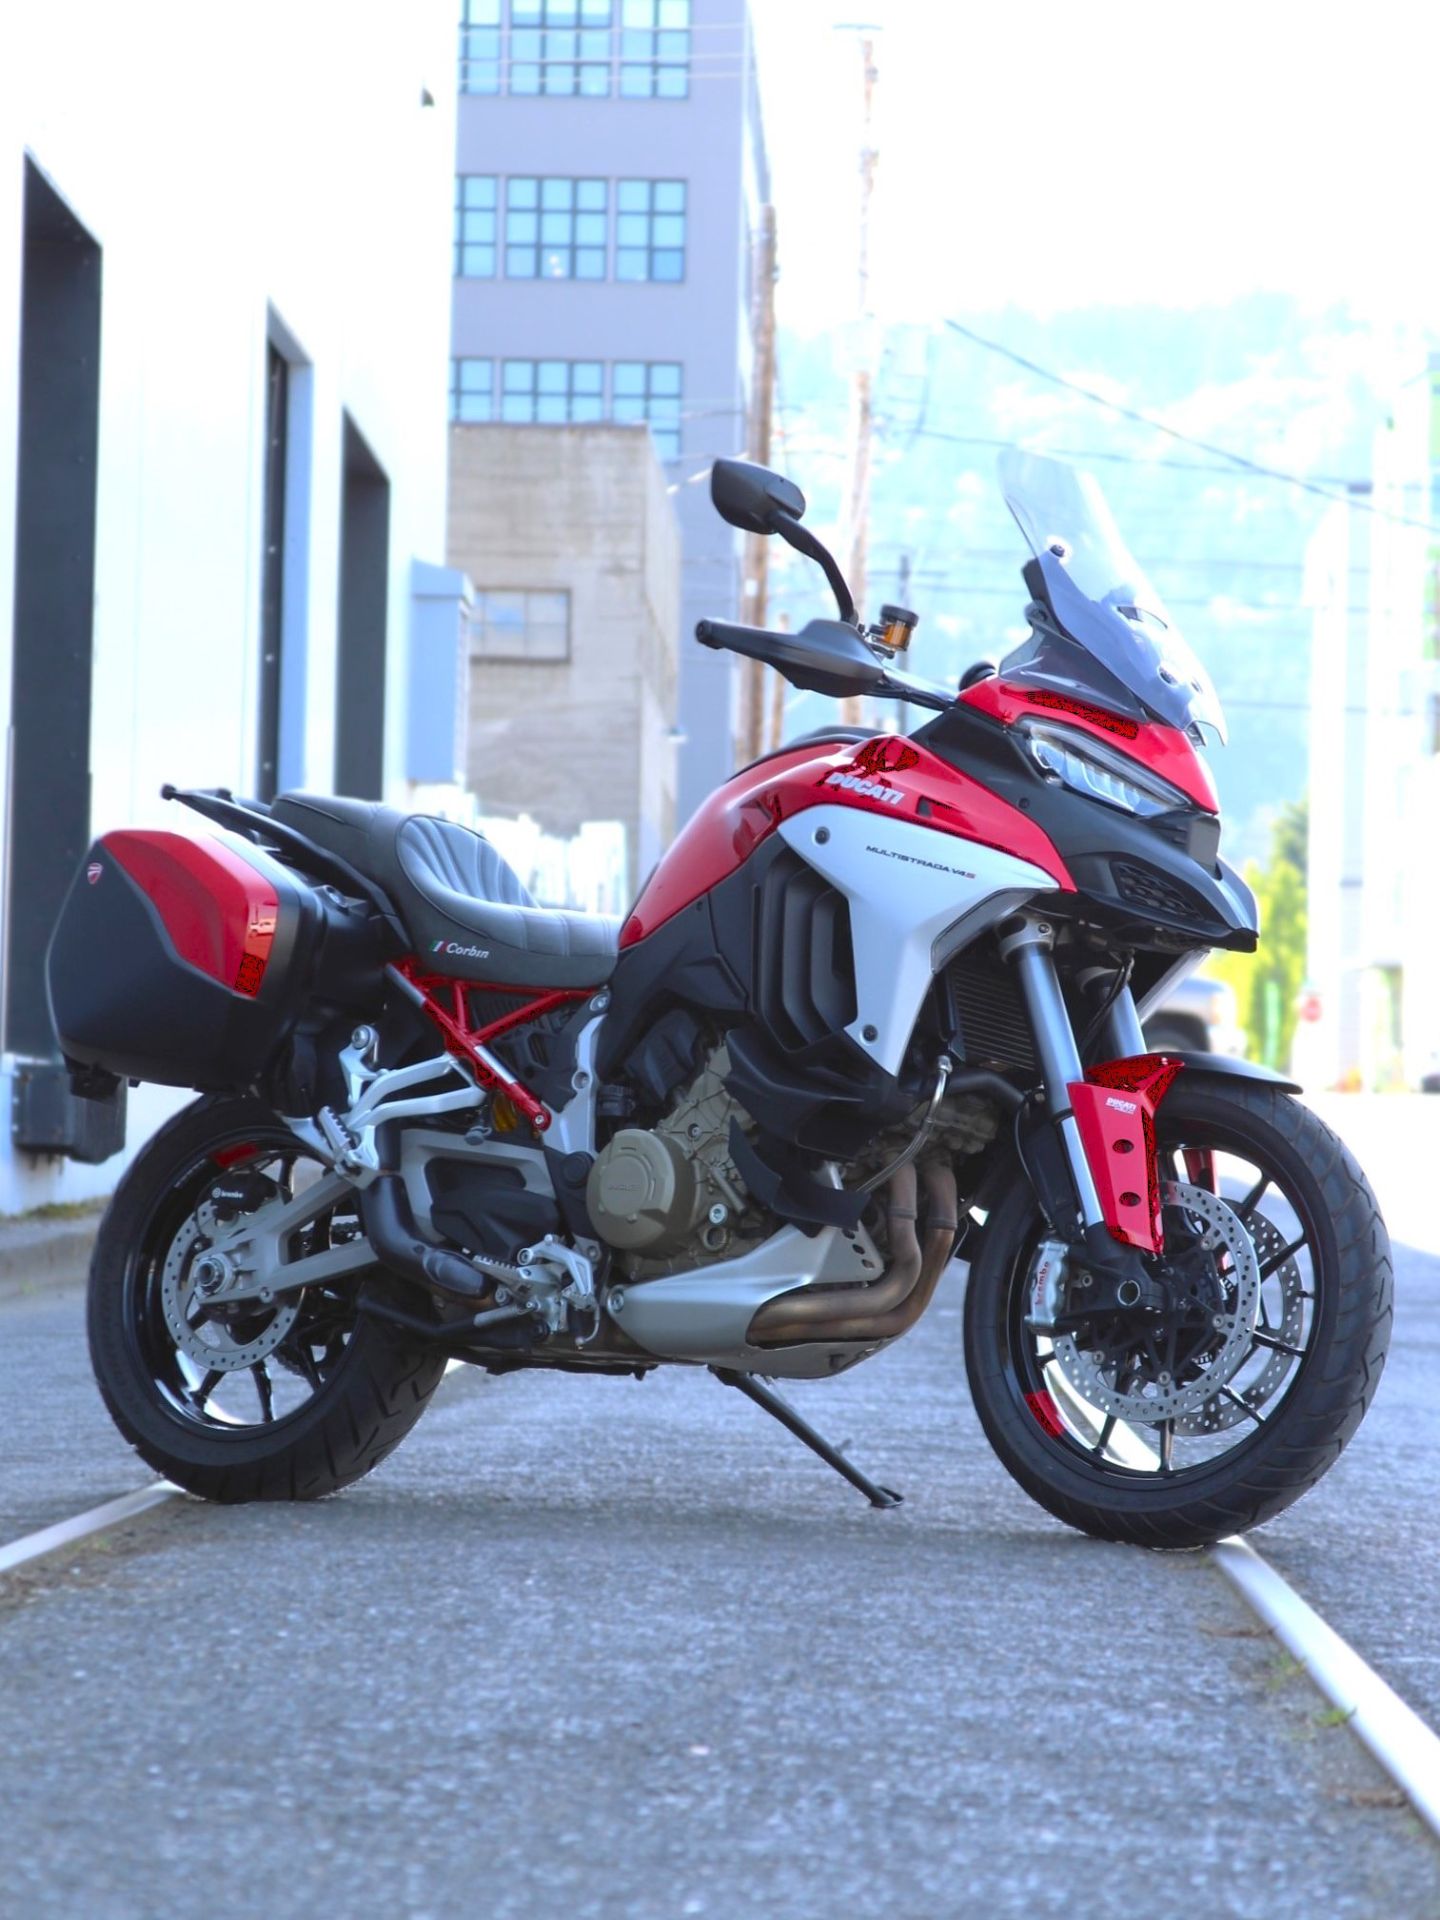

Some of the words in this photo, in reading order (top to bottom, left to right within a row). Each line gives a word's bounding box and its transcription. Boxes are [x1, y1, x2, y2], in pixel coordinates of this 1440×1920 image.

[824, 771, 905, 805] DUCATI
[865, 845, 950, 872] MULTISTRADA
[446, 942, 490, 959] Corbin
